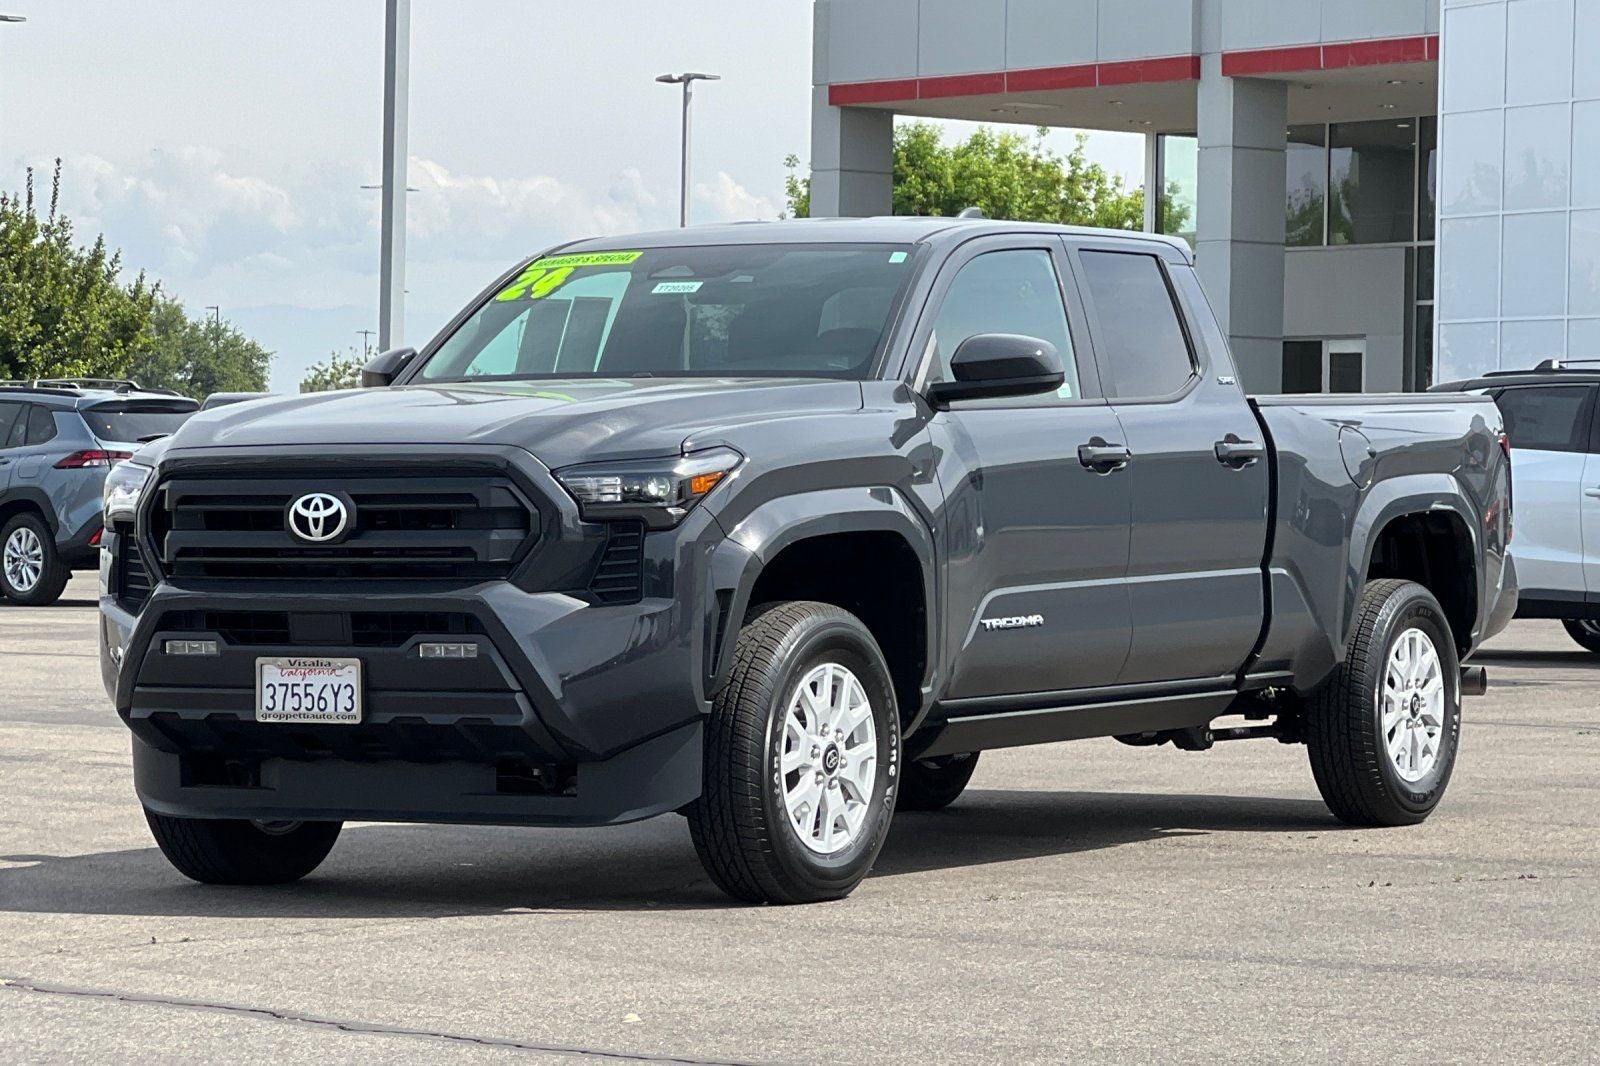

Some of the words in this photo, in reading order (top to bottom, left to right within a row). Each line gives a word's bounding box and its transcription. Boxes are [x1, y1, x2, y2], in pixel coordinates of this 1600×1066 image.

[591, 253, 635, 264] SPECIAL
[980, 614, 1044, 629] TACOMA
[288, 659, 331, 667] Visalia
[280, 667, 343, 681] California
[265, 683, 355, 712] 37556Y3
